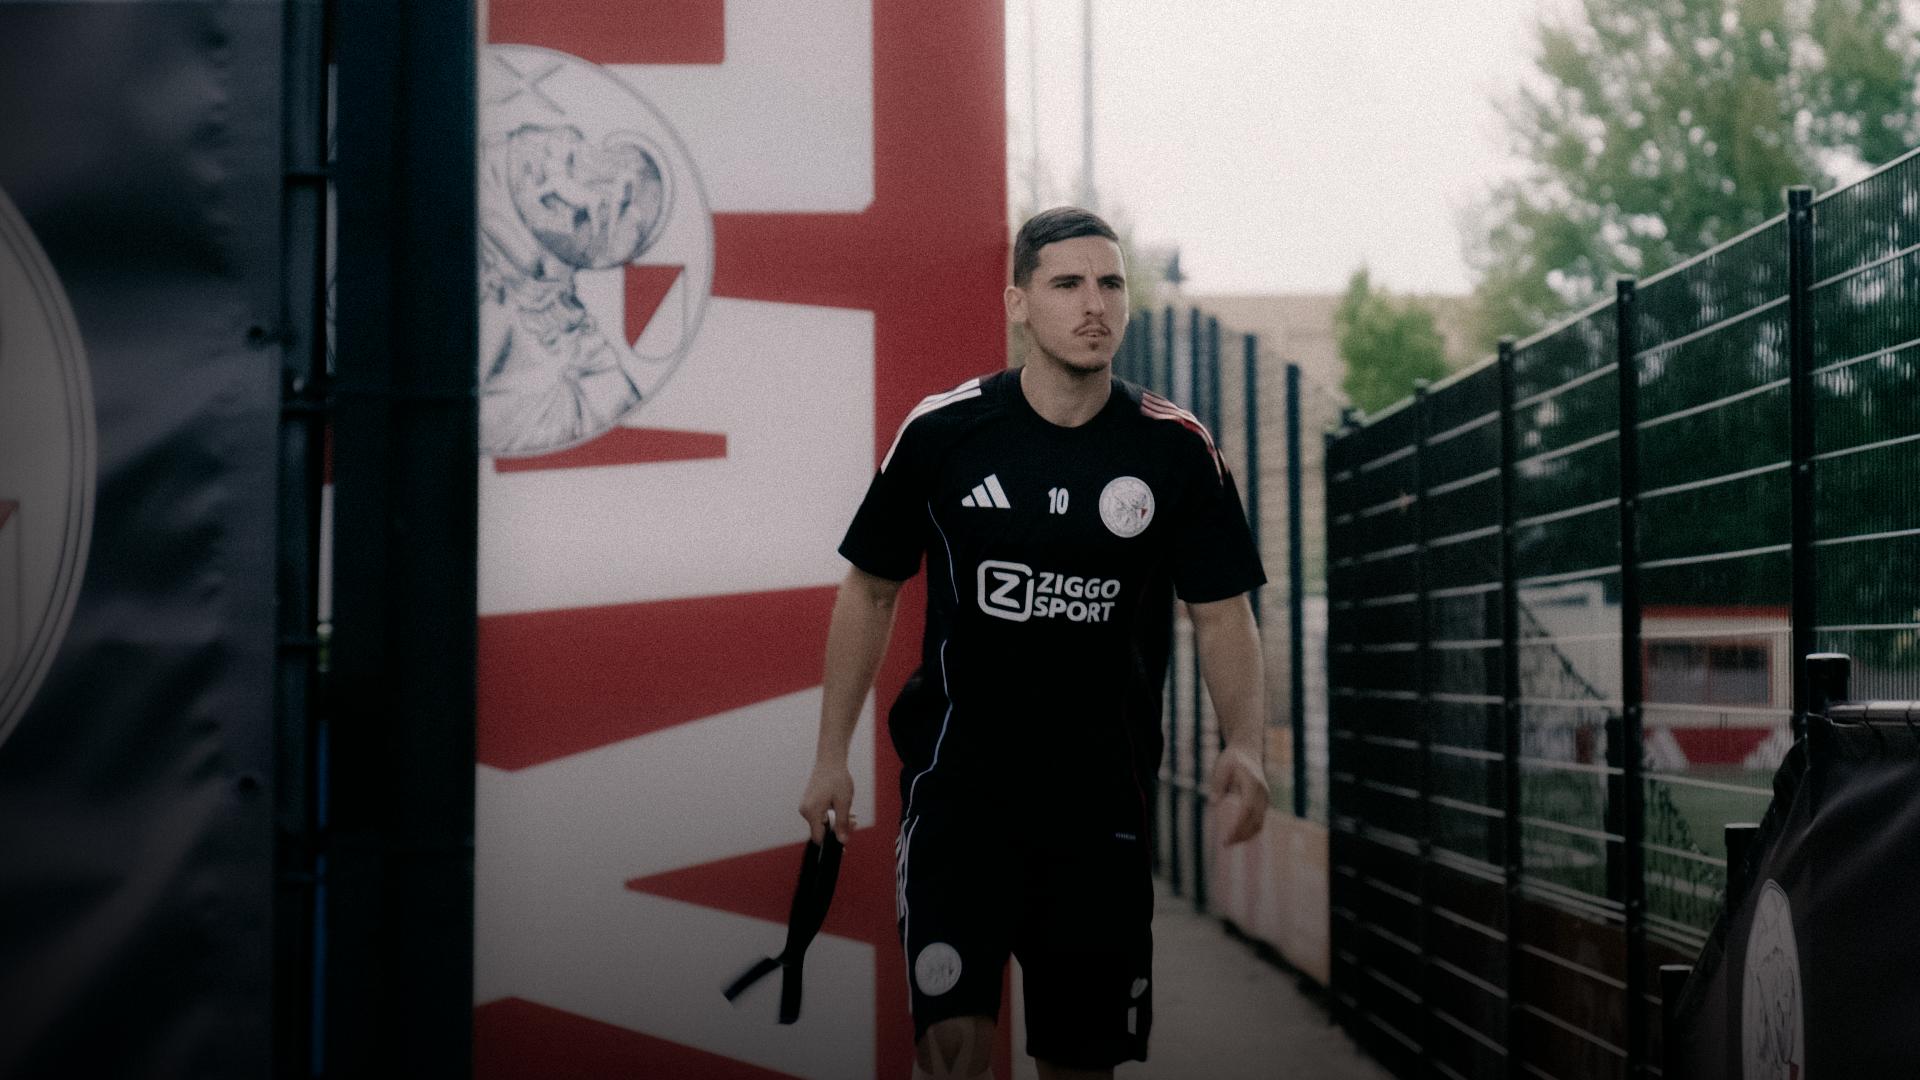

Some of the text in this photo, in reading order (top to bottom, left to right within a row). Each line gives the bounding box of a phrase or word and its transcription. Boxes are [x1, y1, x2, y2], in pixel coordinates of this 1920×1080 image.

[1048, 487, 1069, 515] 10
[1036, 571, 1121, 600] ZIGGO
[1032, 596, 1116, 623] SPORT
